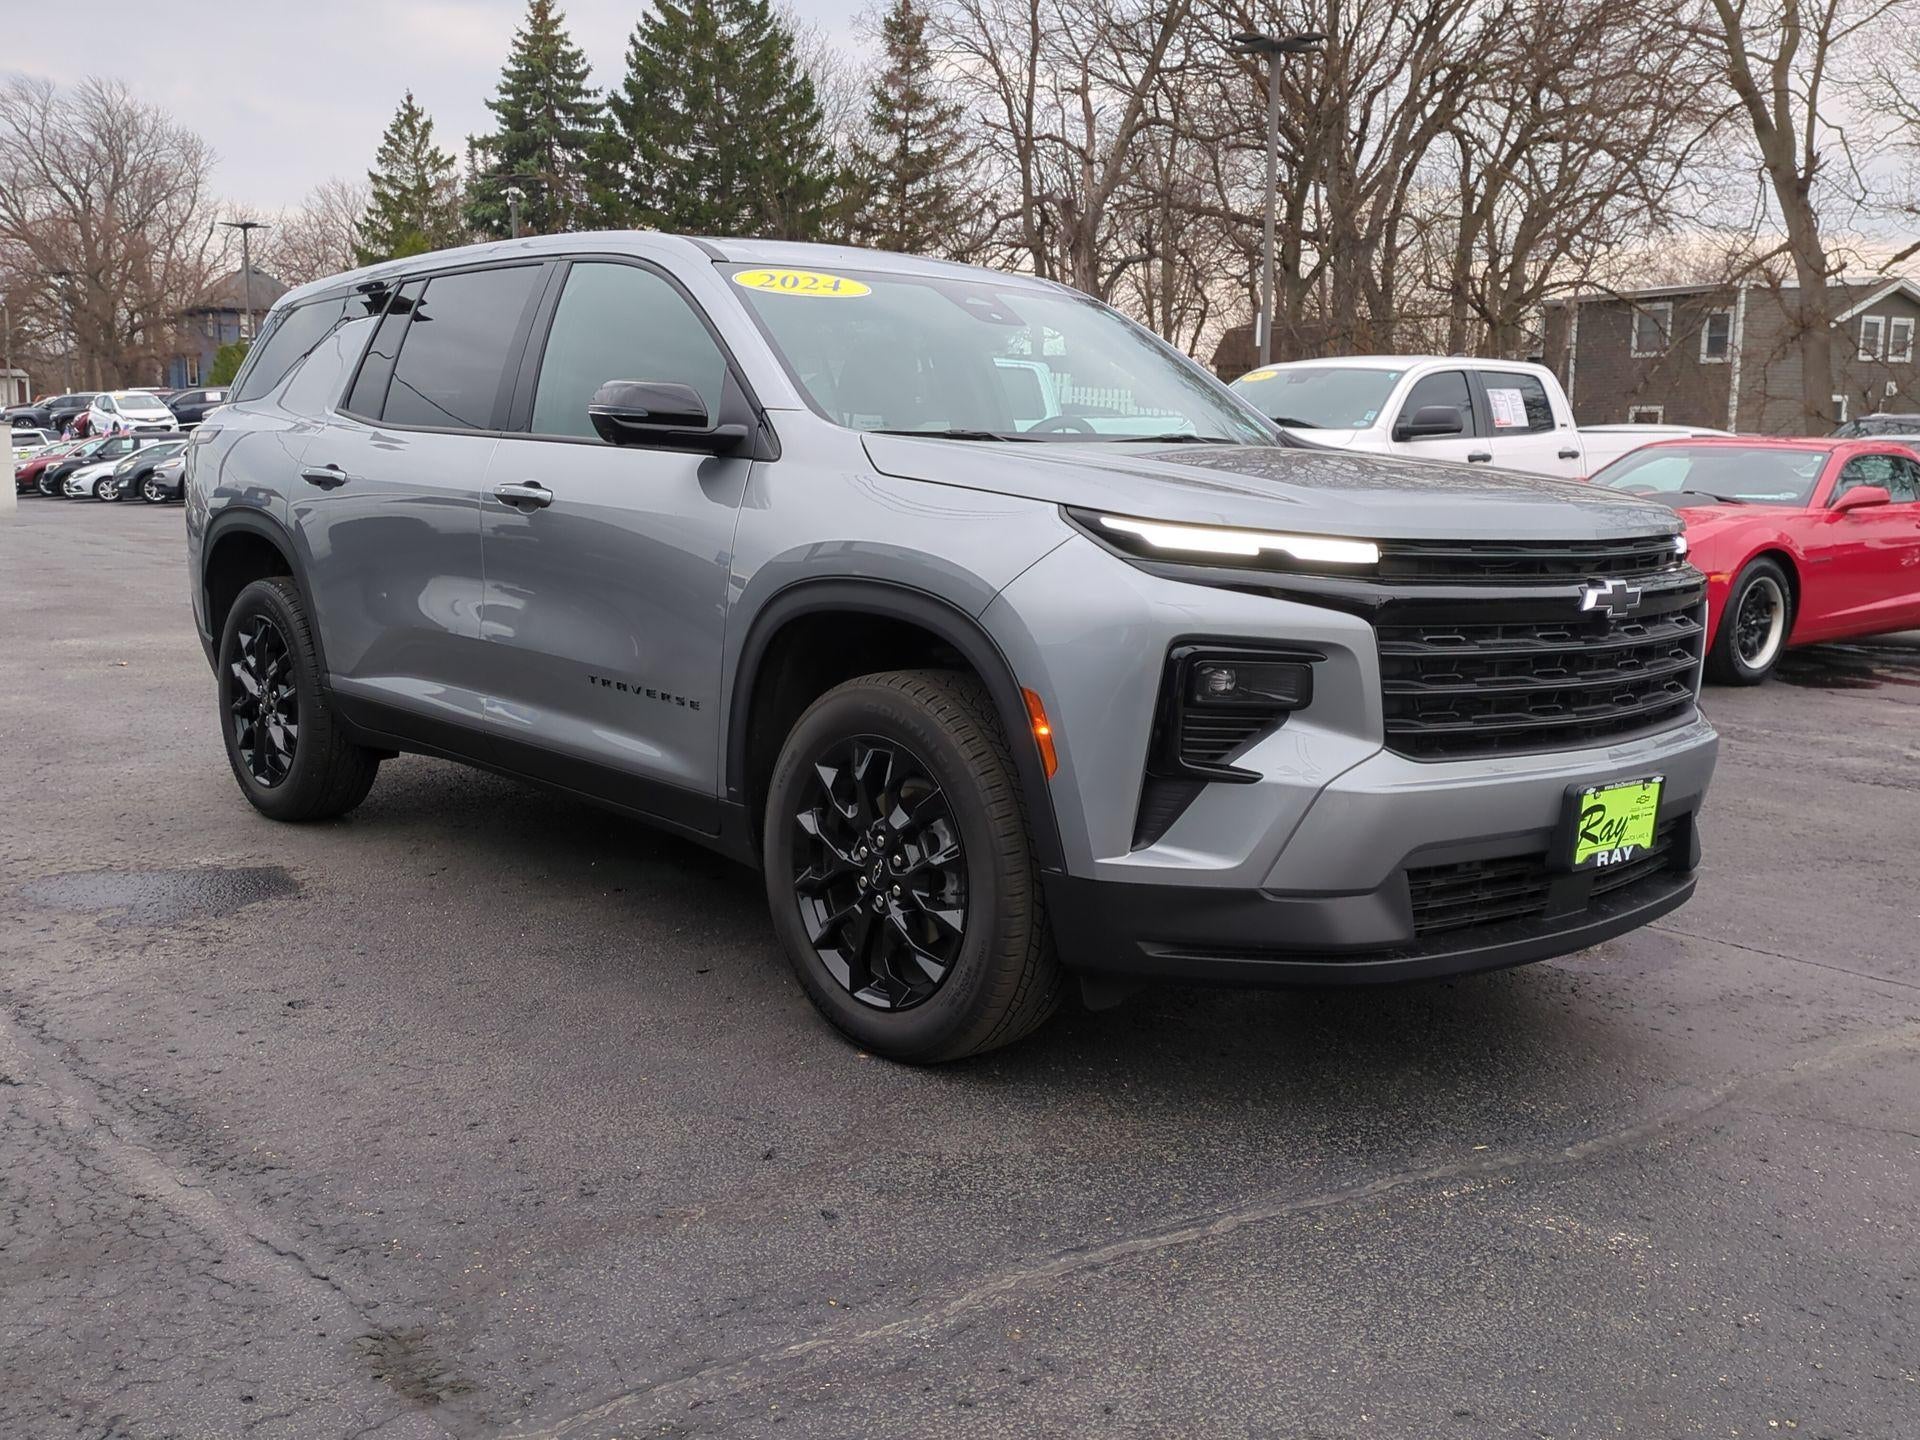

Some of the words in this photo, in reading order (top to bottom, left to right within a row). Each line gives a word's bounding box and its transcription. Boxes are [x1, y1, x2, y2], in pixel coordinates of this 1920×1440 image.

[758, 273, 842, 292] 2024
[588, 675, 700, 711] TRAVERSE
[1578, 803, 1630, 849] Ray
[1596, 845, 1634, 867] RAY
